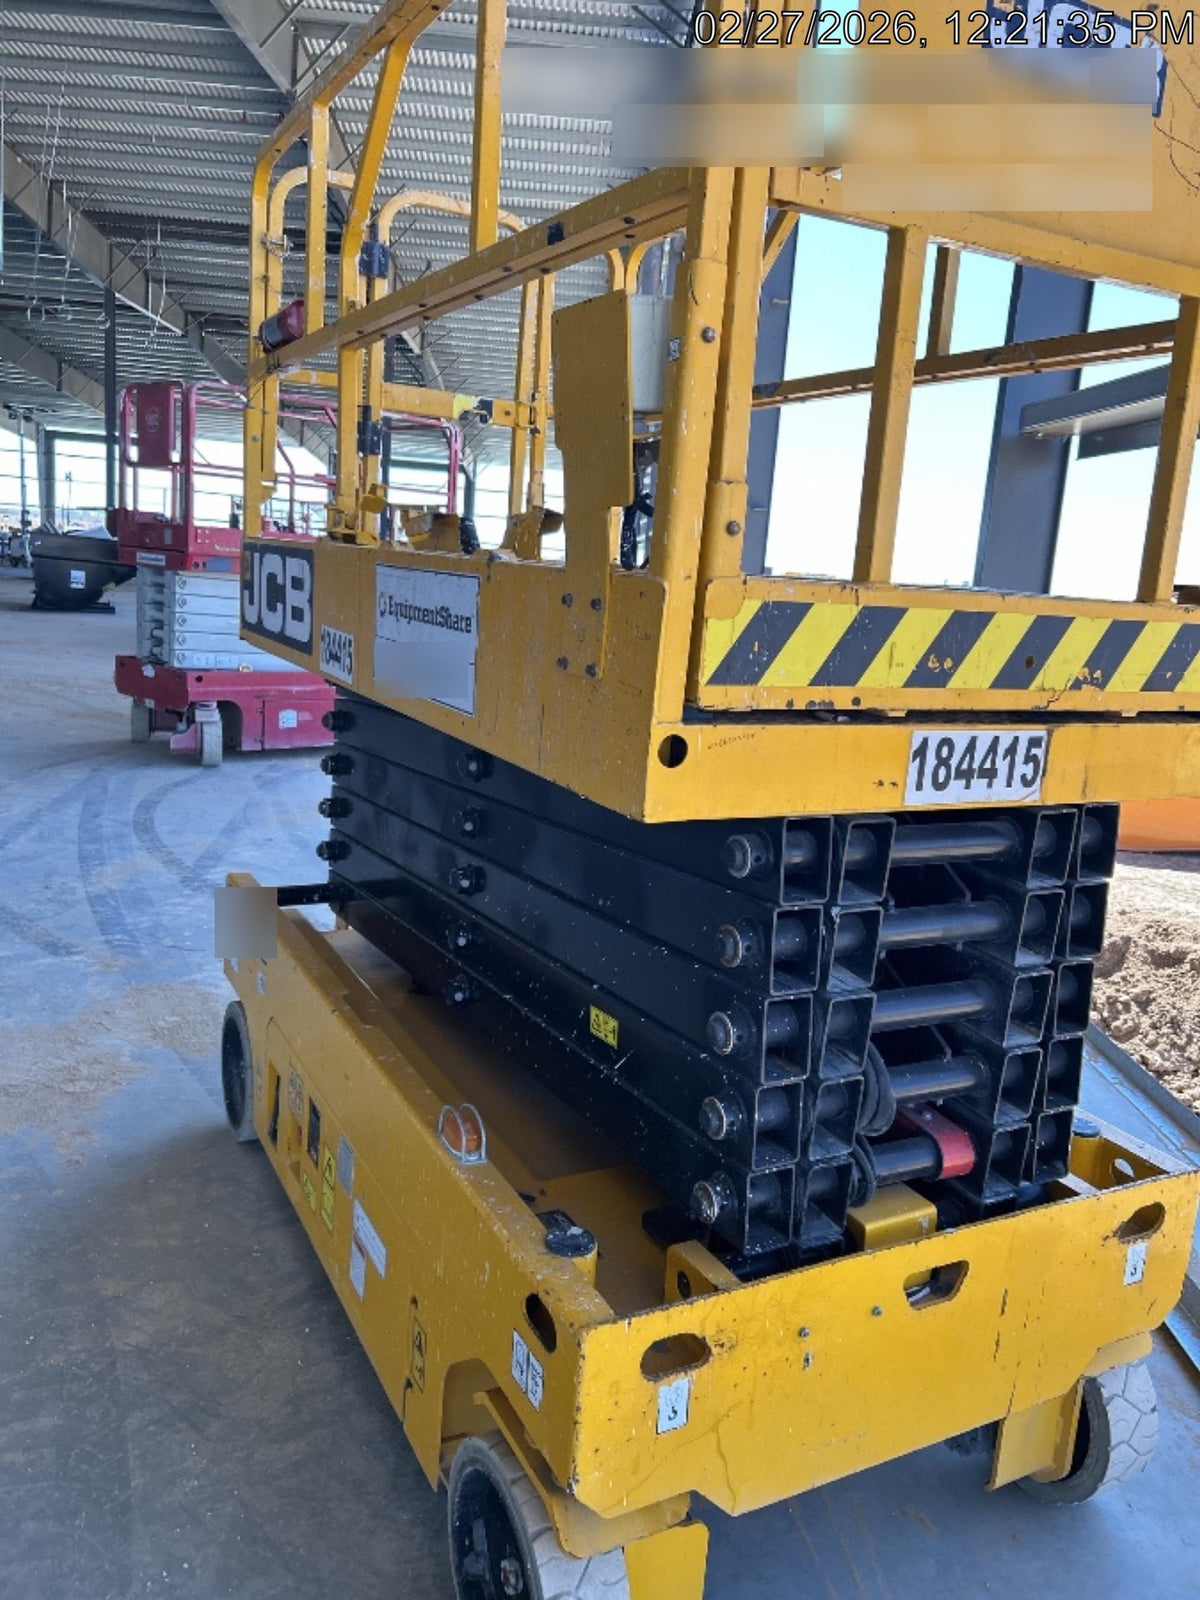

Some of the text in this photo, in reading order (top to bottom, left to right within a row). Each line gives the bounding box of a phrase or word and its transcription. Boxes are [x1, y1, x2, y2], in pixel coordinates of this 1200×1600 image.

[243, 552, 312, 643] JCB
[388, 595, 472, 634] EquipmentShare
[911, 735, 1045, 792] 184415
